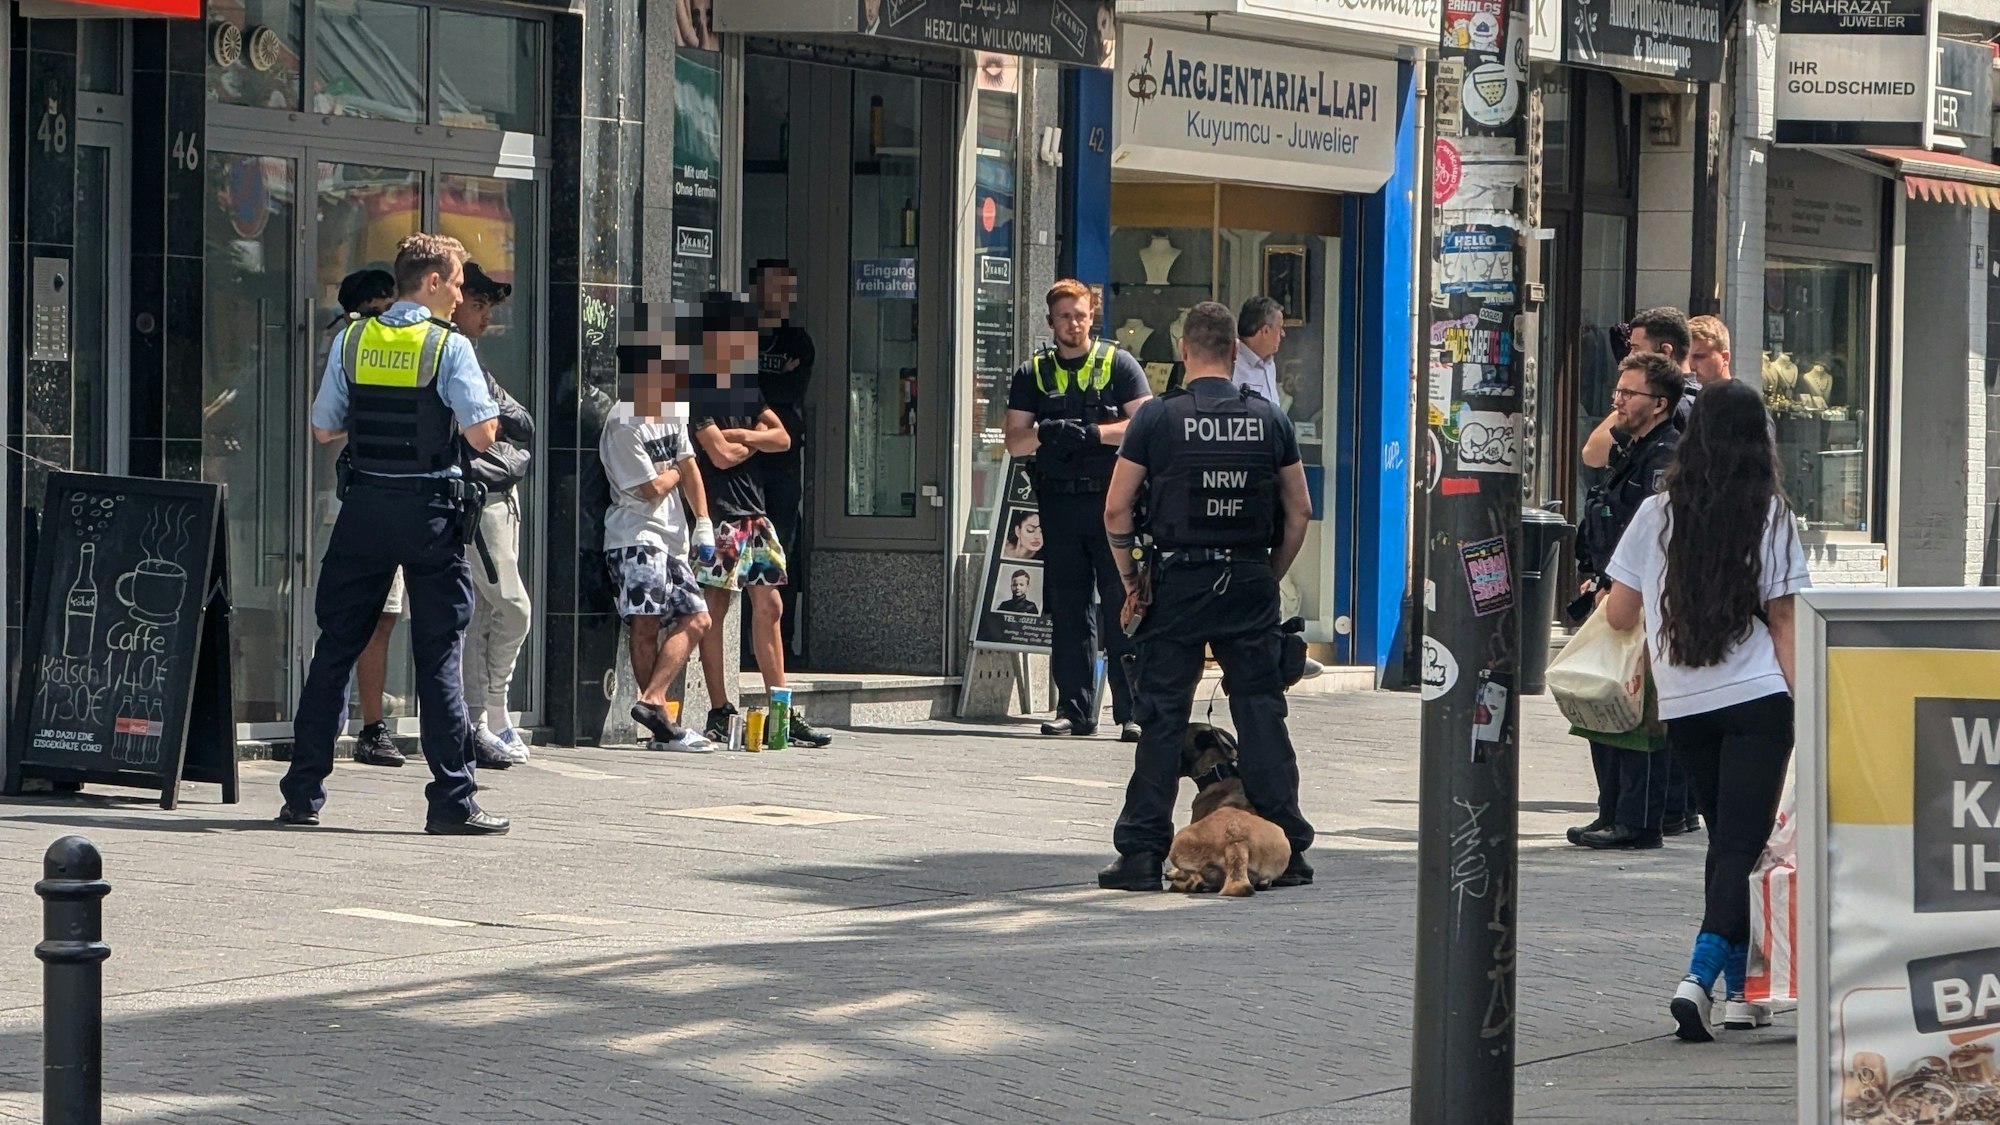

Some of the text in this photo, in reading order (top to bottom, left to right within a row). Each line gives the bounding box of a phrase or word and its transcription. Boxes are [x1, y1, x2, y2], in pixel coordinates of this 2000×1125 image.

[1789, 0, 1891, 14] SHAHRAZAT
[1839, 16, 1905, 28] JUWELIER
[925, 17, 1052, 54] HERZLICH WILLKOMMEN
[1633, 34, 1691, 71] & Boutique
[1788, 61, 1818, 75] IHR
[1160, 50, 1378, 122] ARGJENTARIA-LLAPI
[1788, 80, 1916, 95] GOLDSCHMIED
[37, 112, 67, 154] 48
[1088, 126, 1105, 153] 42
[1187, 109, 1270, 147] Kuyumcu
[1288, 121, 1359, 154] Juwelier
[172, 130, 199, 171] 46
[684, 164, 709, 180] Mit und
[675, 181, 717, 198] Ohne Termin
[1454, 235, 1497, 246] HELLO
[863, 263, 915, 279] Eingang
[856, 278, 917, 291] freihalten
[360, 348, 416, 370] POLIZEI
[1183, 417, 1265, 442] POLIZEI
[1202, 470, 1248, 489] NRW
[1206, 498, 1244, 517] DHF
[106, 621, 166, 654] Caffe
[41, 654, 100, 684] Kölsch
[103, 651, 174, 695] 1,40€
[38, 682, 107, 726] 1,30€
[56, 730, 76, 740] DAZU
[77, 732, 95, 742] EINE
[1952, 781, 2000, 828] K
